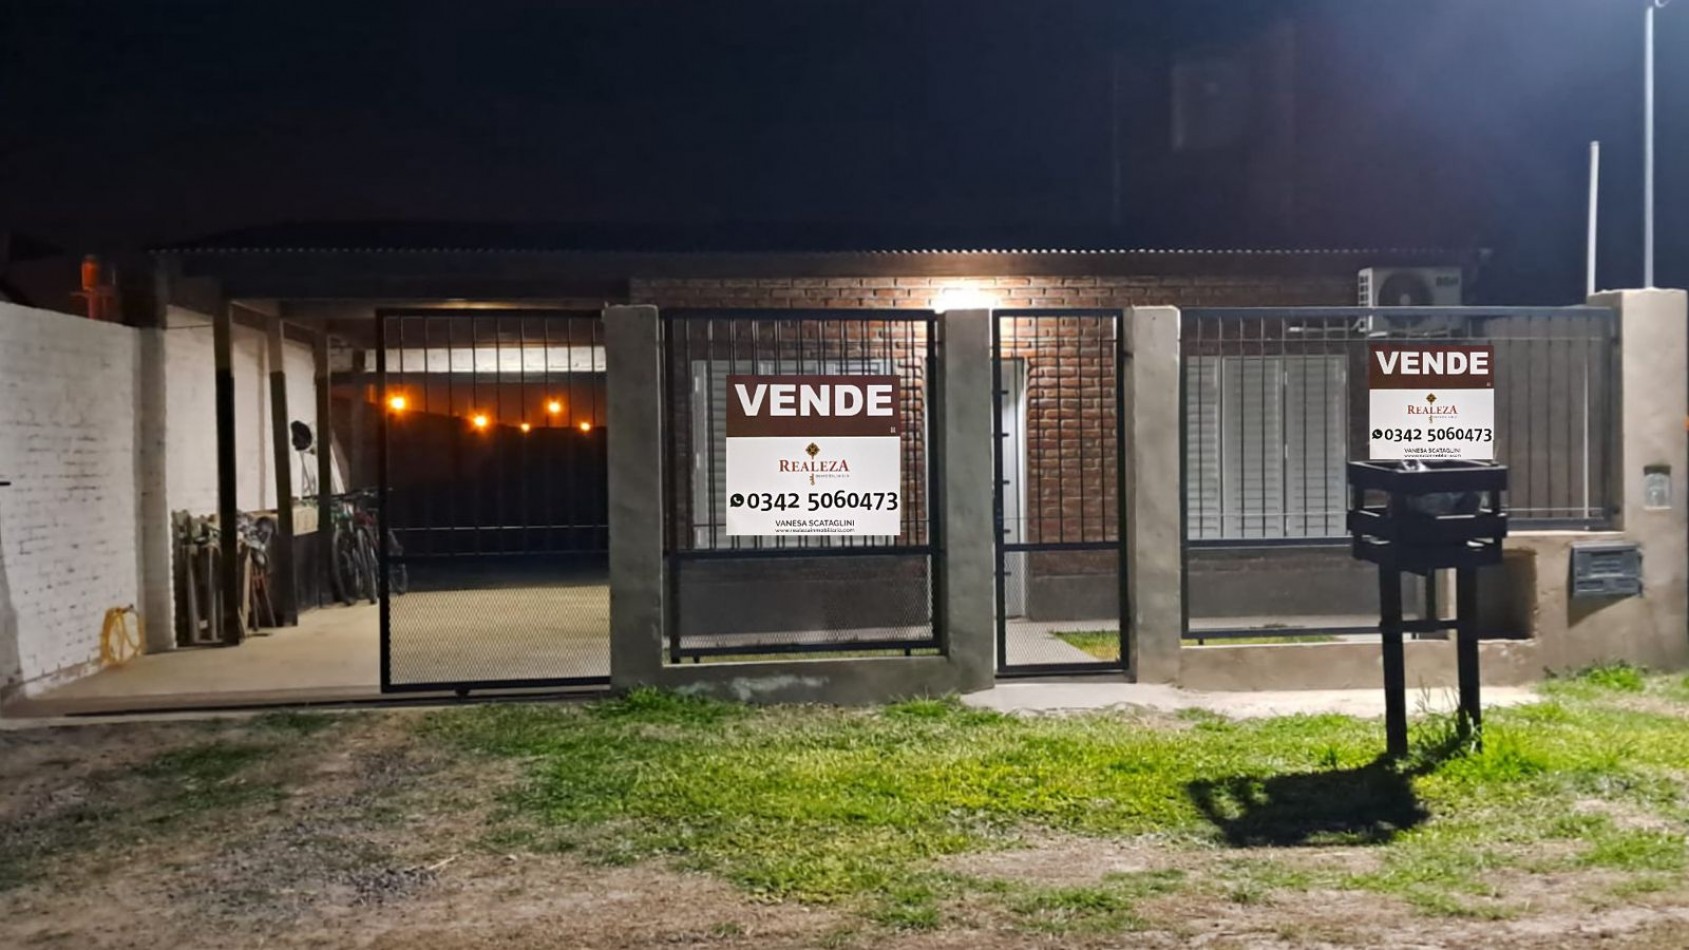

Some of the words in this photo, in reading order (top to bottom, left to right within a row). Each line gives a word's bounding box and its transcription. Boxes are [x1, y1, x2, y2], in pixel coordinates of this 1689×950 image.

[1375, 351, 1489, 375] VENDE
[734, 384, 893, 417] VENDE
[1407, 405, 1459, 414] REALEZA
[1384, 428, 1421, 442] 0342
[1427, 427, 1492, 442] 5060473
[779, 459, 850, 472] REALEZA
[747, 492, 799, 511] 0342
[808, 490, 898, 511] 5060473
[775, 519, 807, 527] VANESA
[808, 519, 855, 527] SCATAGLINI
